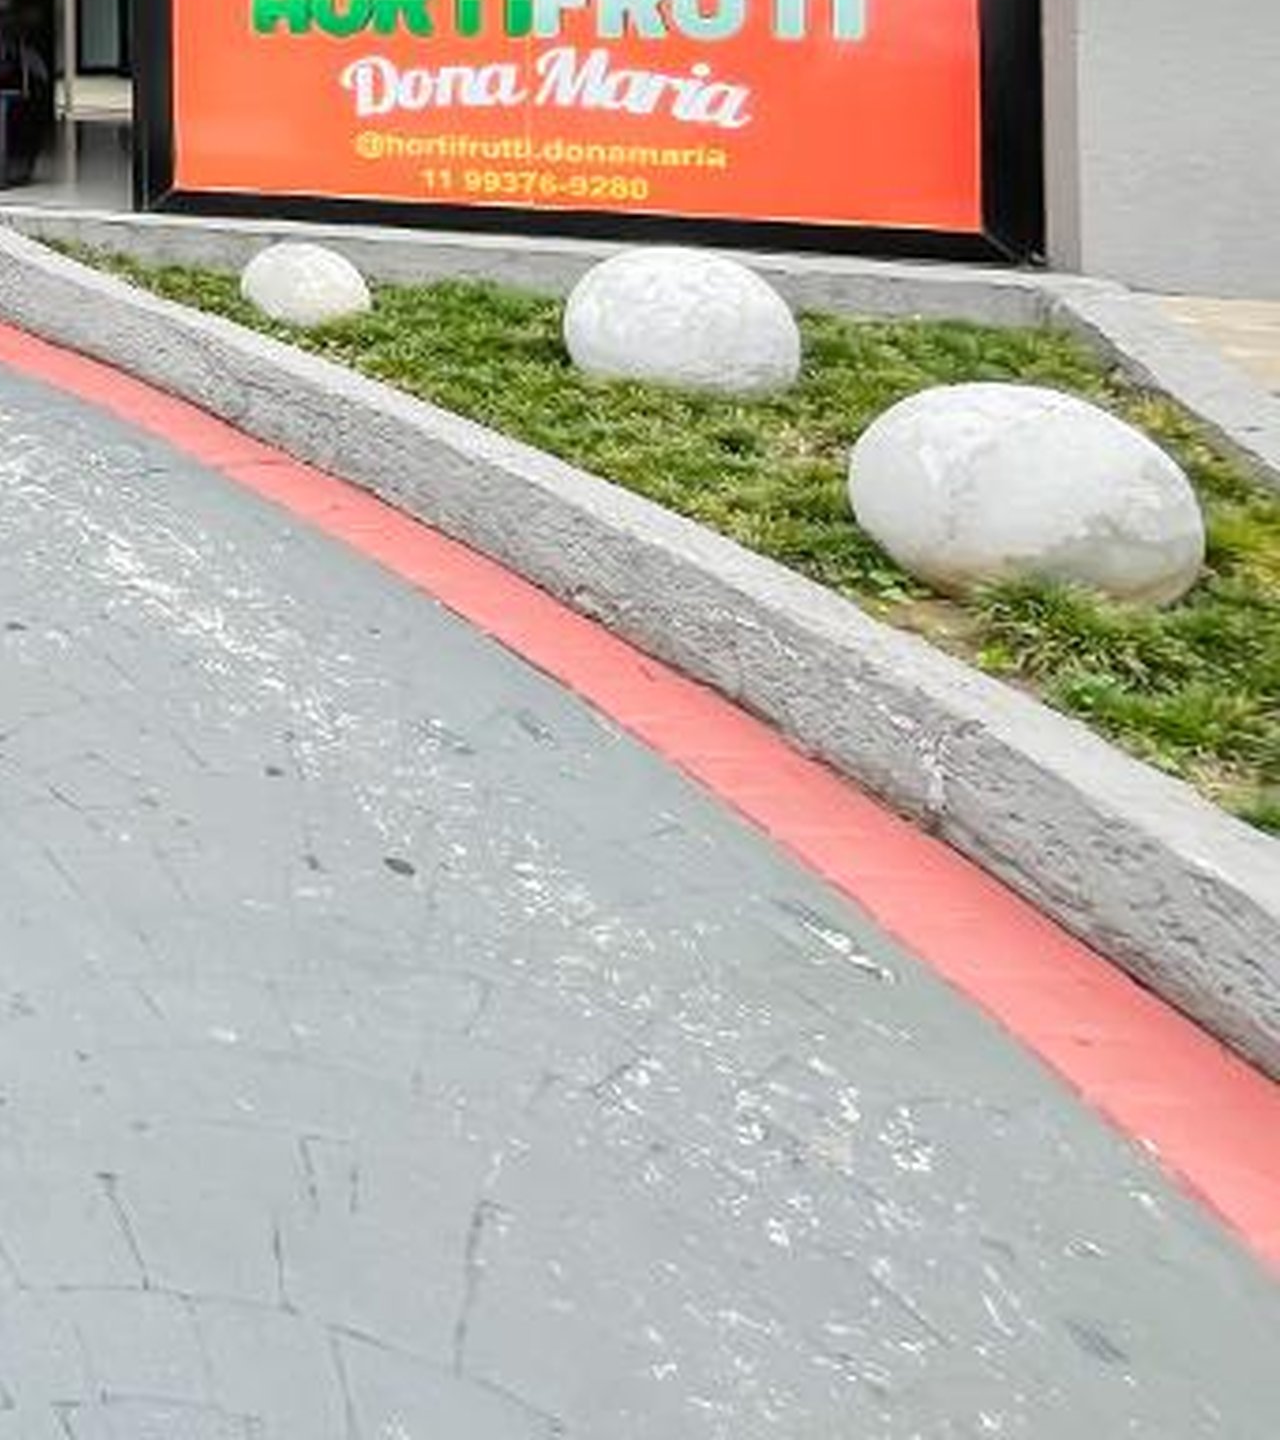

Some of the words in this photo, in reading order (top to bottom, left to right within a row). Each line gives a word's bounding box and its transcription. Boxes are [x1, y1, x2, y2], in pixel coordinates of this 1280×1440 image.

[342, 56, 526, 117] Dona
[535, 46, 752, 128] Maria
[354, 130, 729, 169] @hortifrutti.donamaria
[420, 169, 451, 189] 11
[464, 171, 649, 201] 99376-9280
